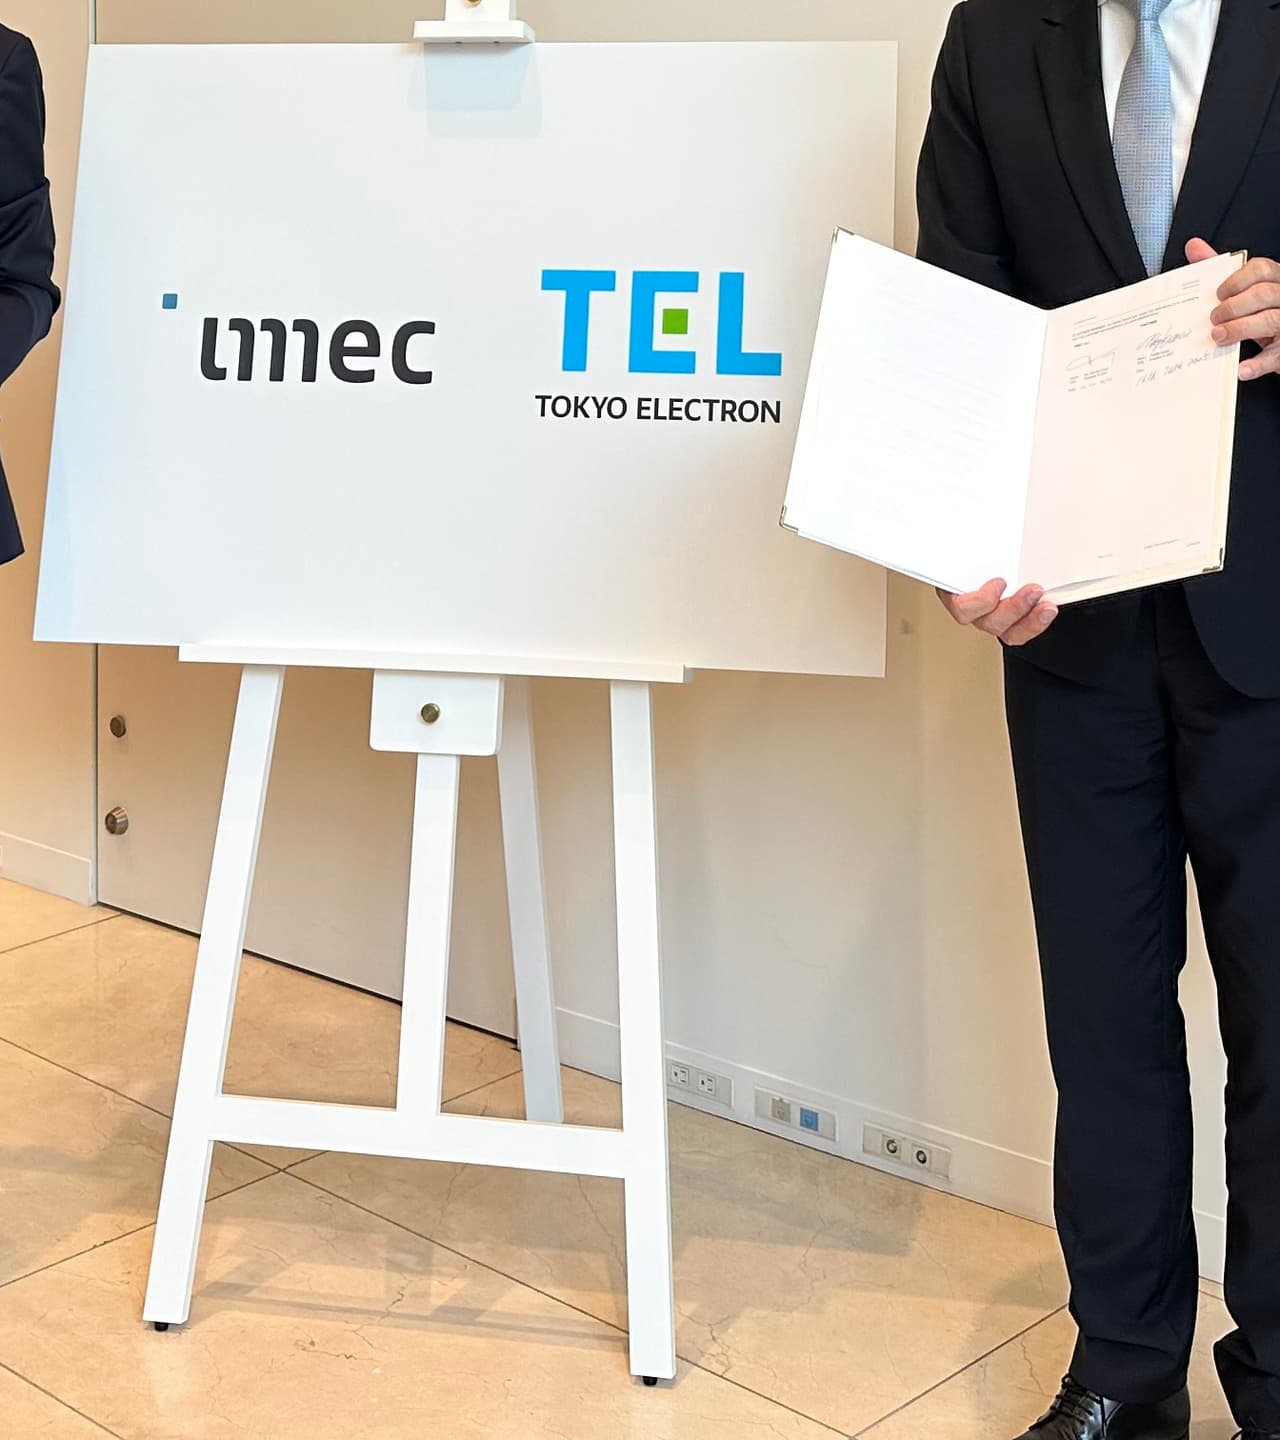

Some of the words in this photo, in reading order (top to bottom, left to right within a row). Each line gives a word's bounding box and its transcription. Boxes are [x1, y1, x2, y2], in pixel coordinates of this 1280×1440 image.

[163, 294, 436, 385] imec
[540, 269, 783, 377] TEL
[534, 394, 628, 420] TOKYO
[636, 397, 781, 423] ELECTRON
